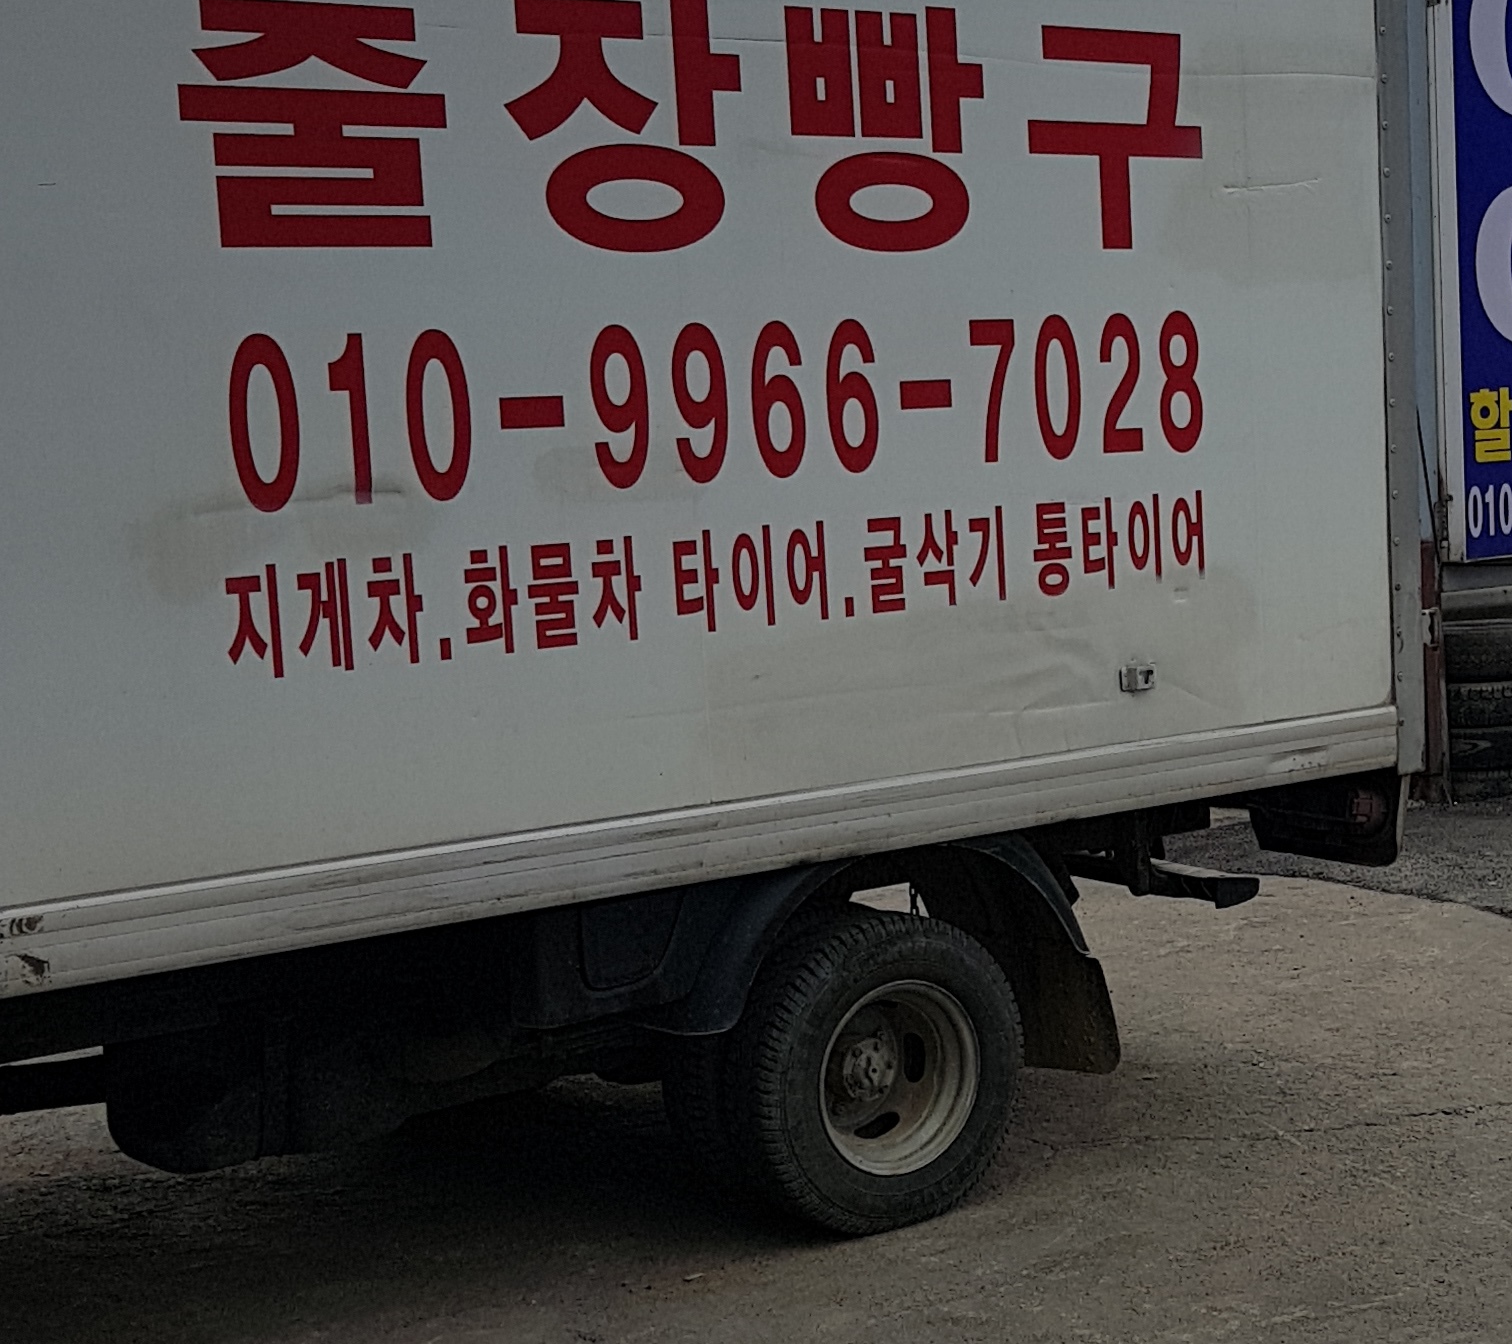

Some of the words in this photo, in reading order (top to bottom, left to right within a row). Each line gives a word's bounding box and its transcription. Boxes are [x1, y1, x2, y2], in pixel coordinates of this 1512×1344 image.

[227, 309, 1205, 513] 010-9966-7028
[223, 535, 642, 680] 지게차.화물차
[1031, 488, 1206, 596] 통타이어
